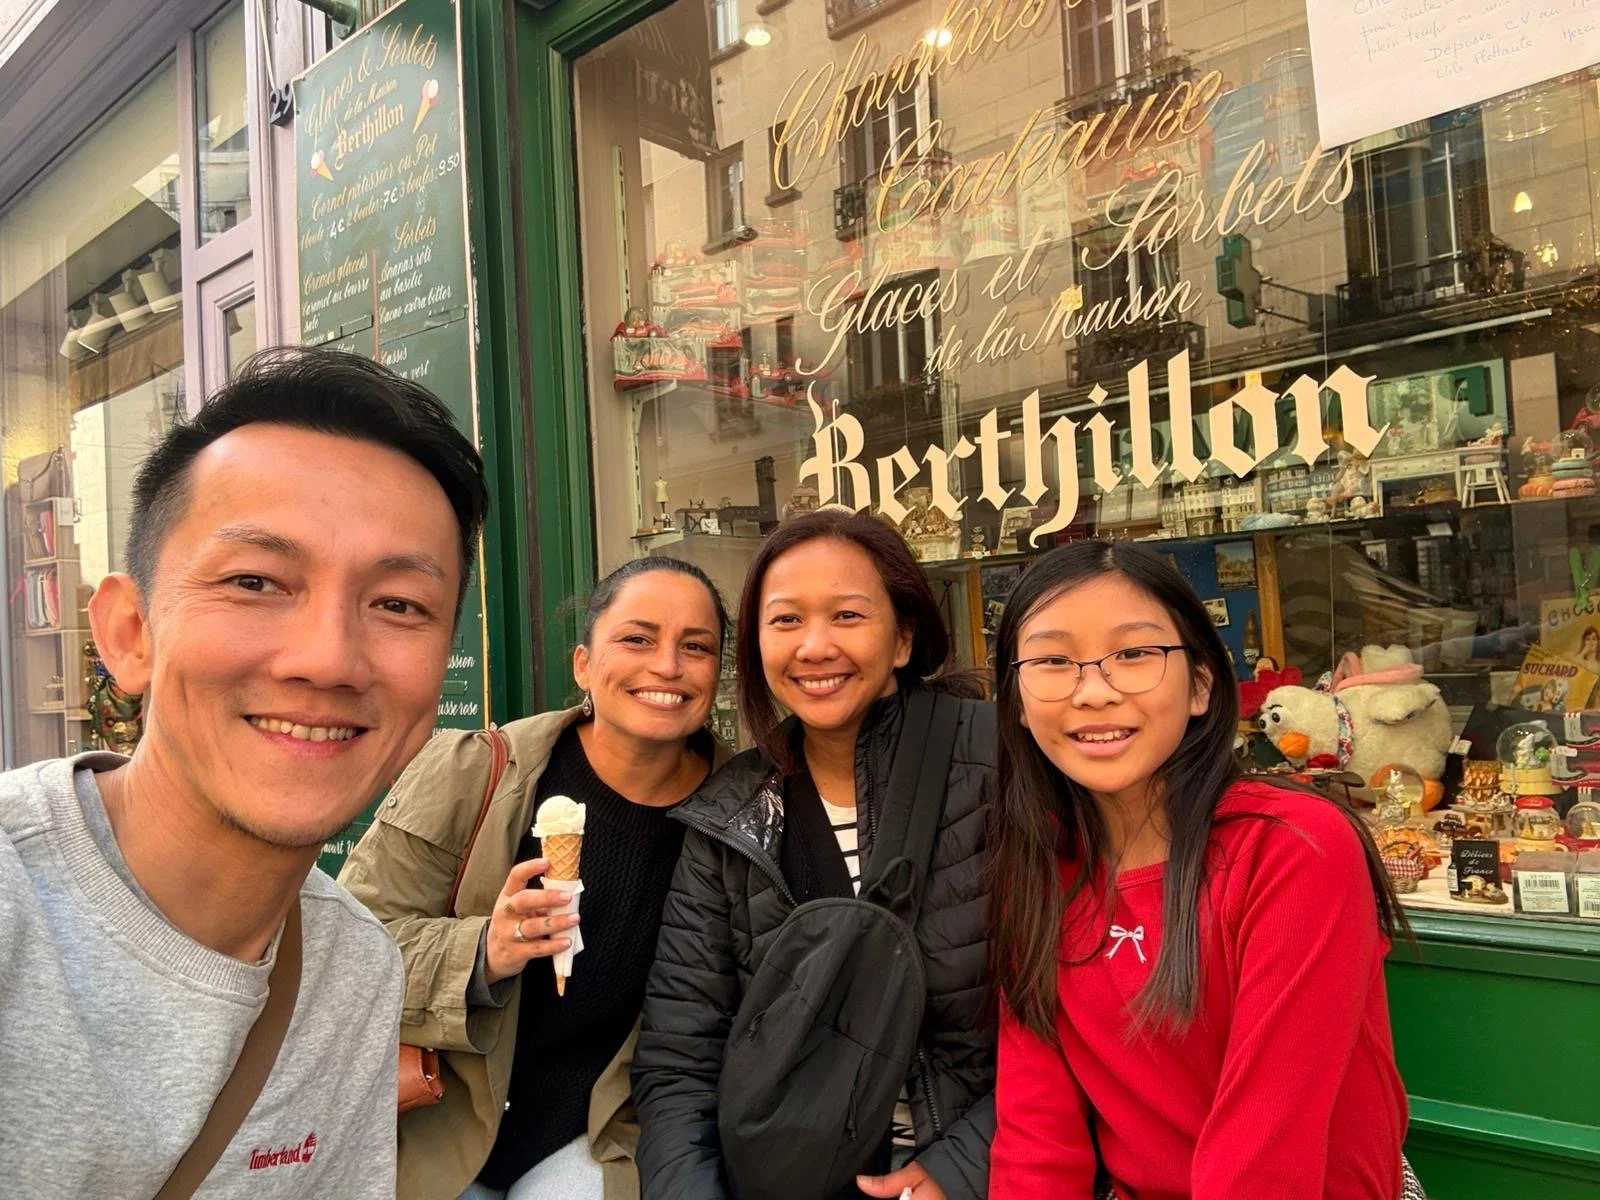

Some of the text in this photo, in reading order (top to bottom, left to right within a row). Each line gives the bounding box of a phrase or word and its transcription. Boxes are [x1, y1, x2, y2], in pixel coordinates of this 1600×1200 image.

[376, 23, 438, 70] Sorbets
[334, 103, 405, 171] Berthillon
[876, 70, 1222, 233] Cadeaux
[393, 214, 437, 254] Sorbets
[1081, 138, 1354, 270] Sorbets
[795, 230, 1051, 376] Glaces et
[924, 273, 1203, 376] de la Maison
[799, 349, 1391, 549] Berthillon
[1522, 662, 1579, 678] SUCHARD
[1463, 867, 1495, 876] France
[249, 1143, 303, 1170] Timberland
